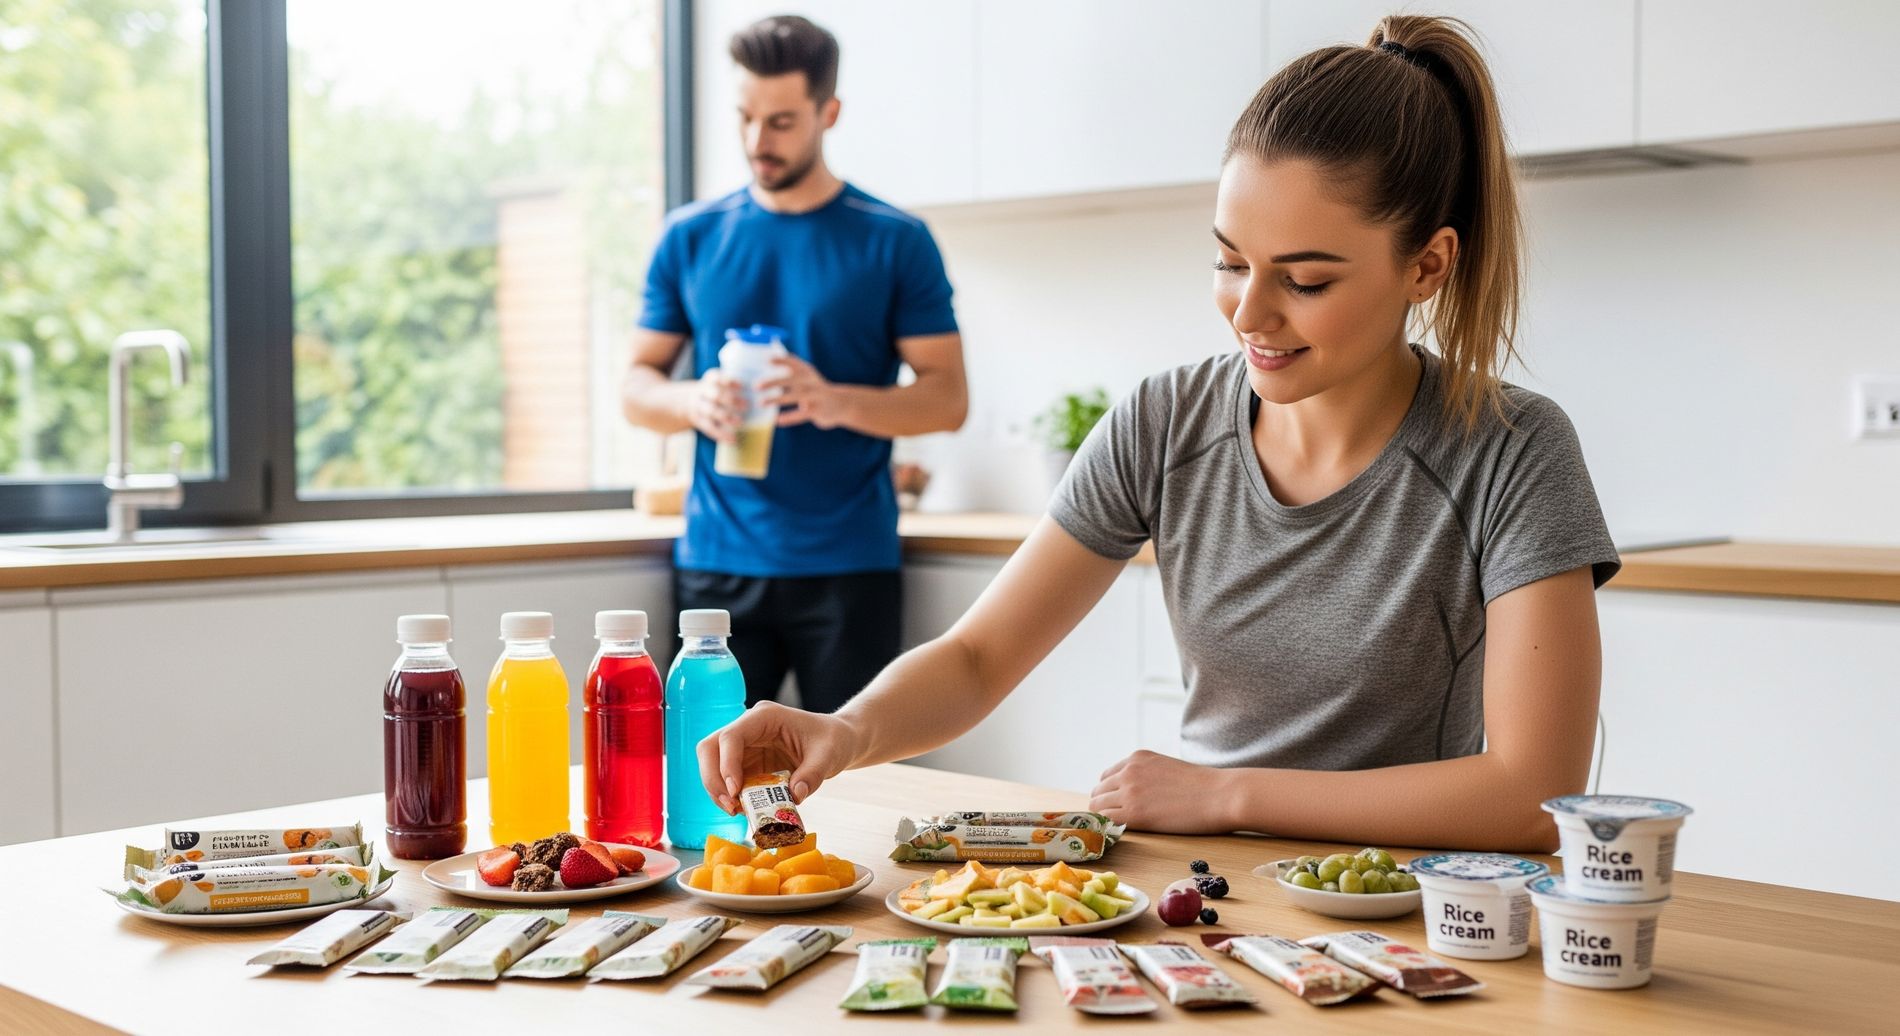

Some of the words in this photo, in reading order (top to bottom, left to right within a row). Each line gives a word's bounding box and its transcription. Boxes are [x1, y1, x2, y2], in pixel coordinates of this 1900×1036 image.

[1586, 844, 1633, 865] Rice
[1581, 865, 1643, 883] cream
[1443, 903, 1485, 924] Rice
[1439, 922, 1495, 941] cream
[1565, 928, 1612, 950] Rice
[1560, 948, 1623, 969] cream
